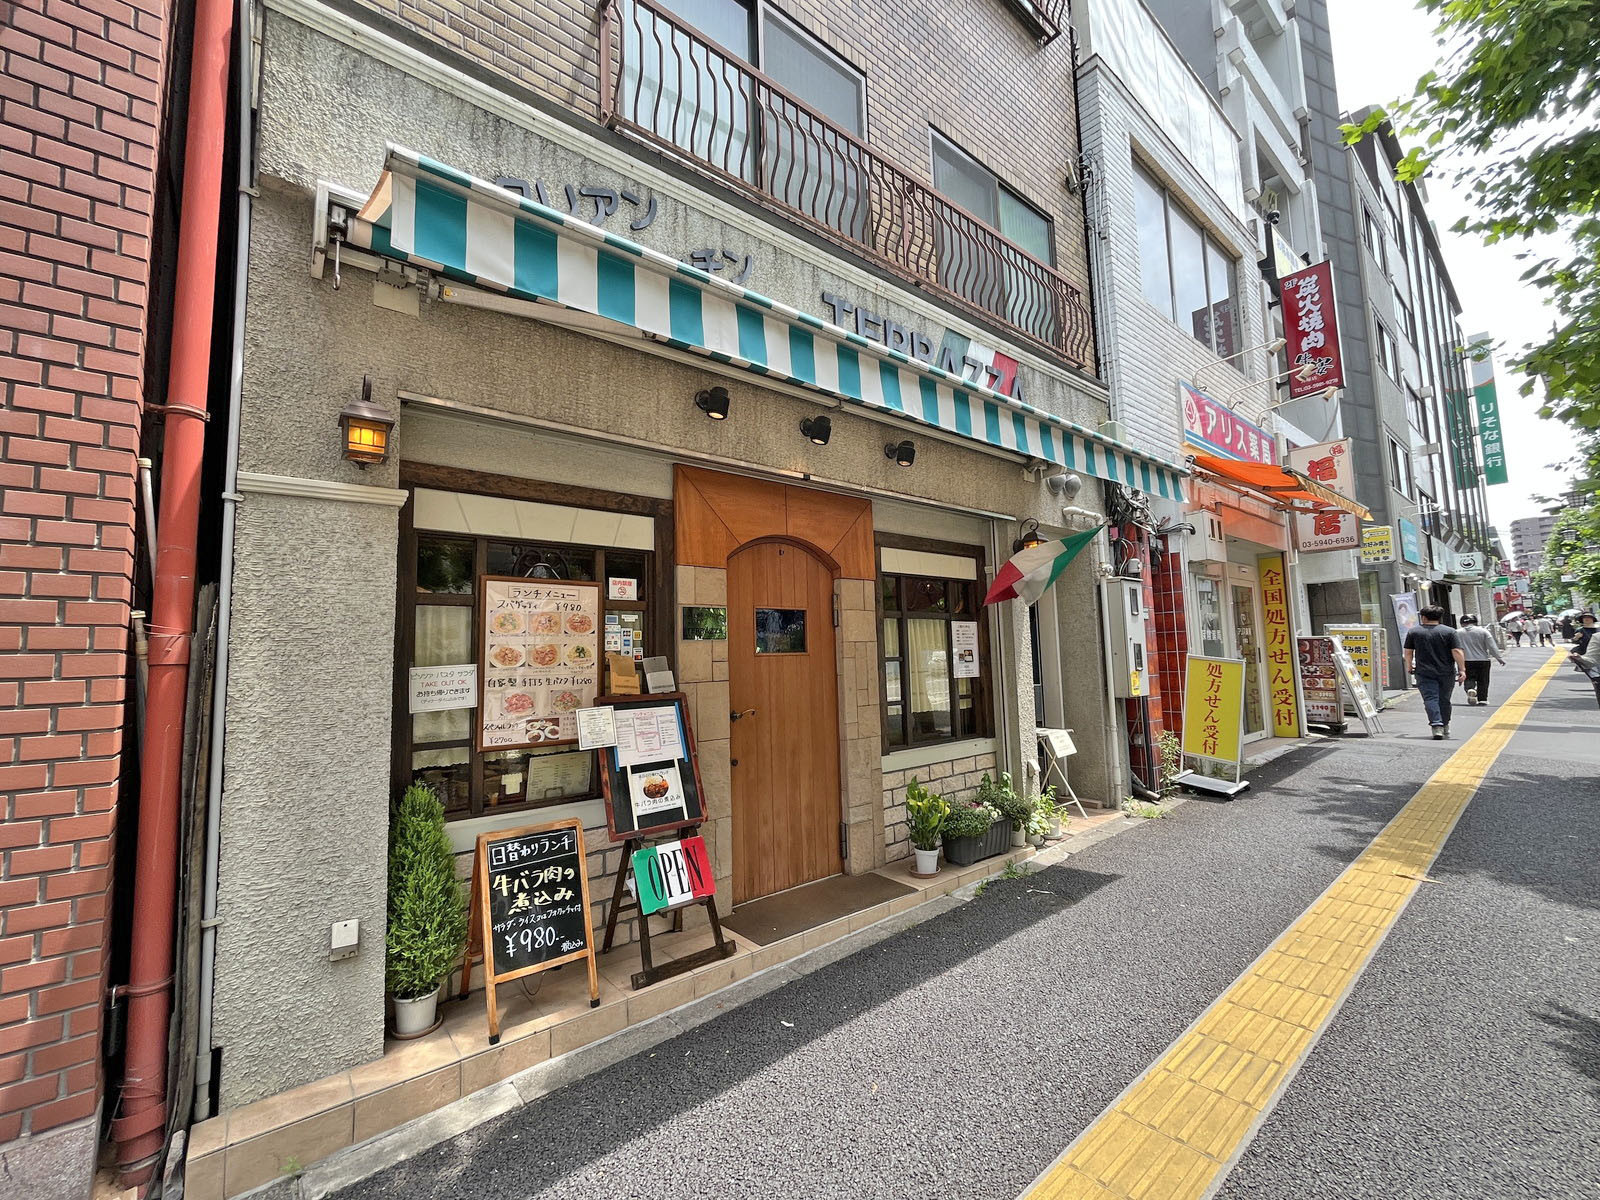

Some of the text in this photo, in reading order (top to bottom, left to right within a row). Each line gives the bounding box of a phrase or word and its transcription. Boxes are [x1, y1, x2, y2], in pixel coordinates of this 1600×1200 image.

[1295, 274, 1325, 352] 炭火焼肉
[1205, 405, 1271, 465] アリス薬局
[1481, 402, 1503, 468] りそな銀行
[1302, 536, 1355, 549] 03-5940-6936
[497, 600, 537, 610] スパゲッティ
[513, 589, 576, 598] ランチメニュー
[1262, 569, 1294, 727] 全国処方せん受付
[1202, 663, 1223, 756] 処方せん受付
[491, 835, 574, 866] 日替わりランチ
[492, 865, 575, 896] 牛バラ肉の
[647, 845, 705, 901] OPEN
[508, 887, 575, 916] 煮込み
